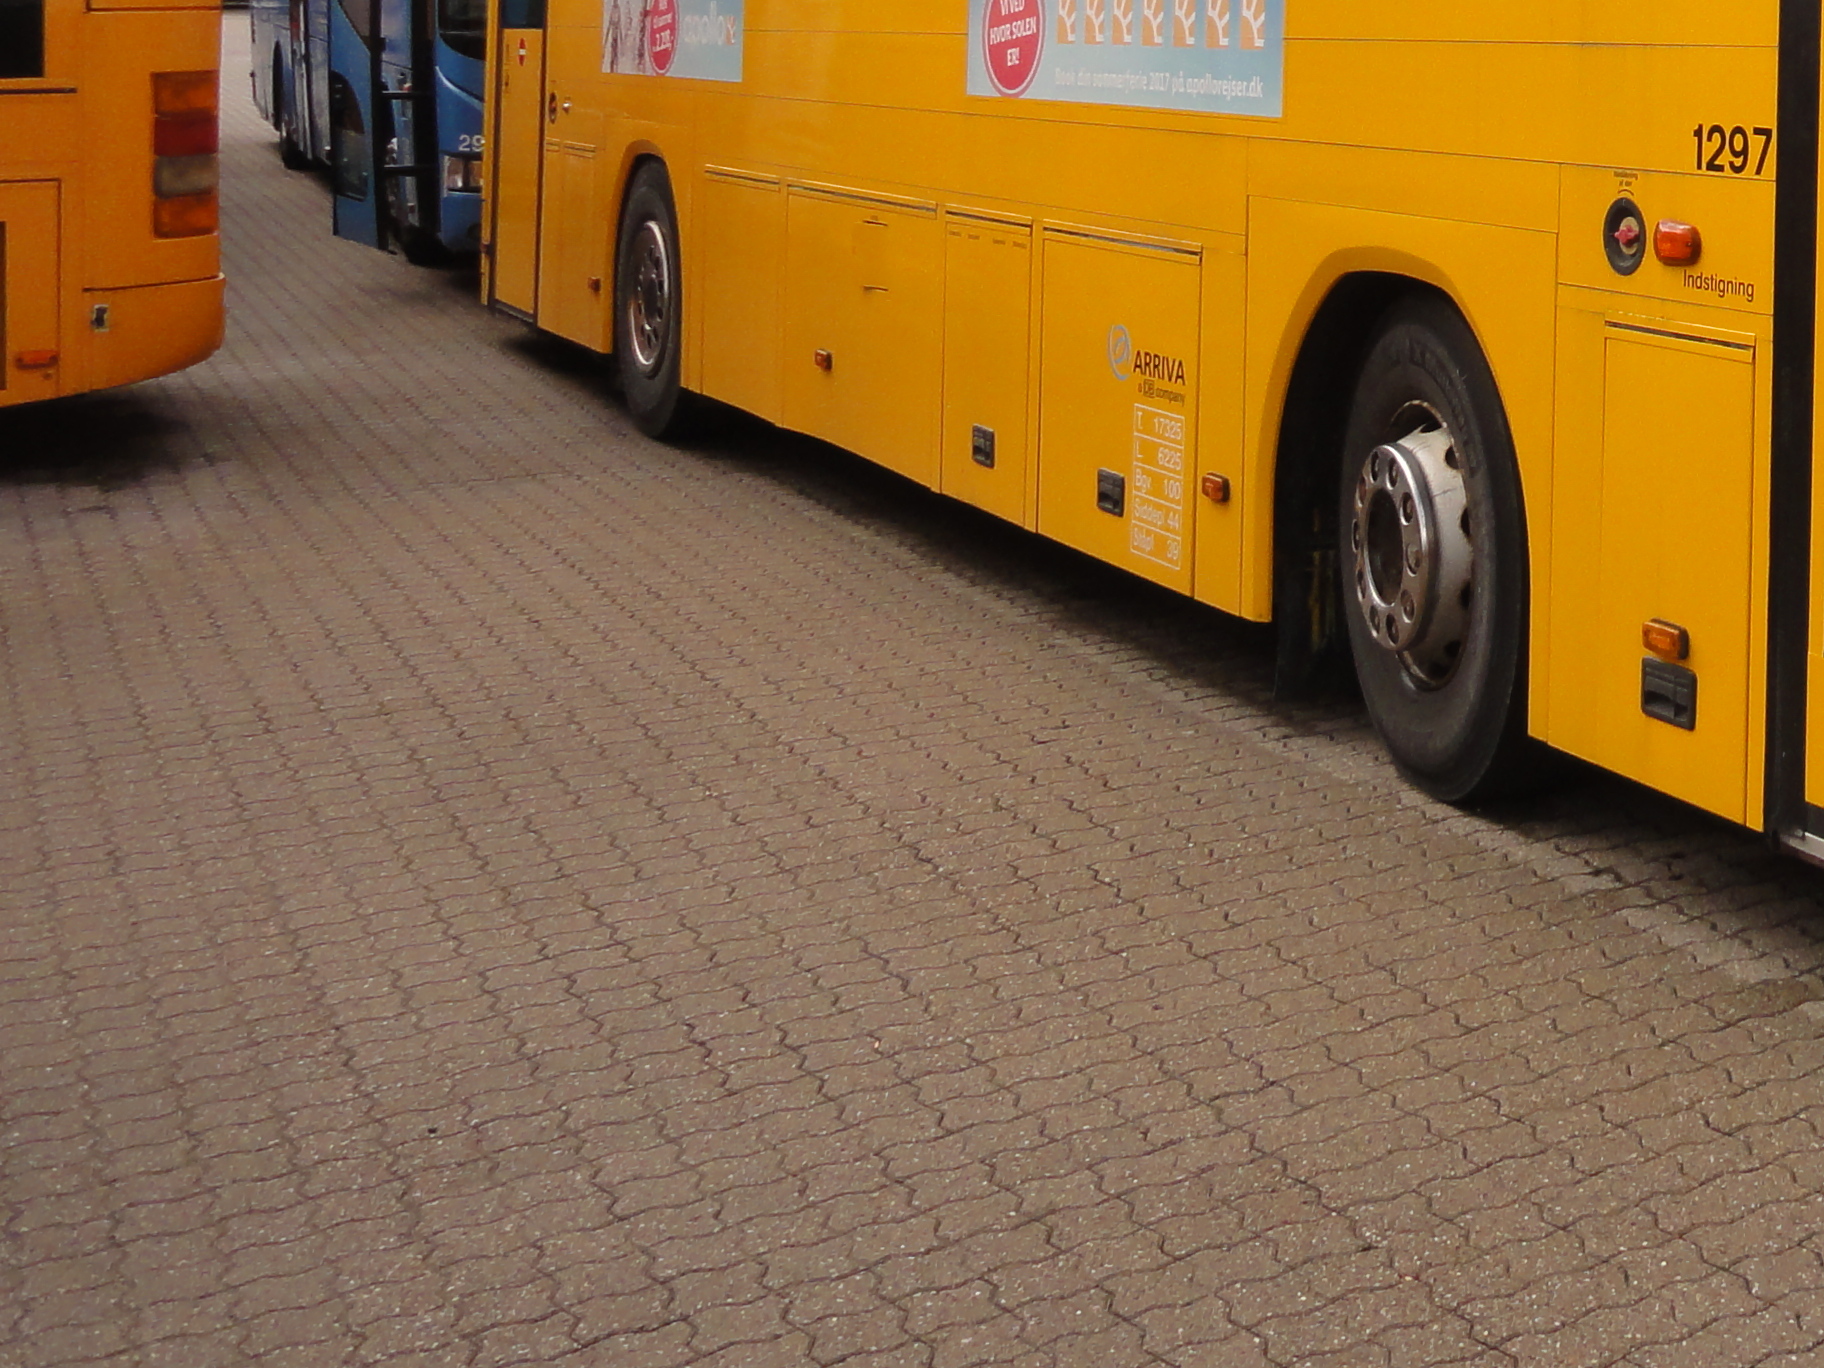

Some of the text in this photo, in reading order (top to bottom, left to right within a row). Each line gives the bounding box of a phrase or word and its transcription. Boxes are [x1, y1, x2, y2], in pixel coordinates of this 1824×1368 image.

[989, 16, 1037, 46] HVOR SOLEN
[1007, 47, 1020, 67] ER!
[1149, 72, 1170, 91] 2017
[1171, 70, 1185, 97] på
[1186, 73, 1264, 101] apollorejser.dk
[1692, 123, 1773, 176] 1297
[1683, 269, 1755, 303] Indstigning
[1132, 349, 1186, 386] ARRIVA
[1154, 417, 1182, 441] 17325
[1157, 447, 1182, 471] 6225
[1164, 478, 1181, 500] 100
[1167, 510, 1179, 530] 44
